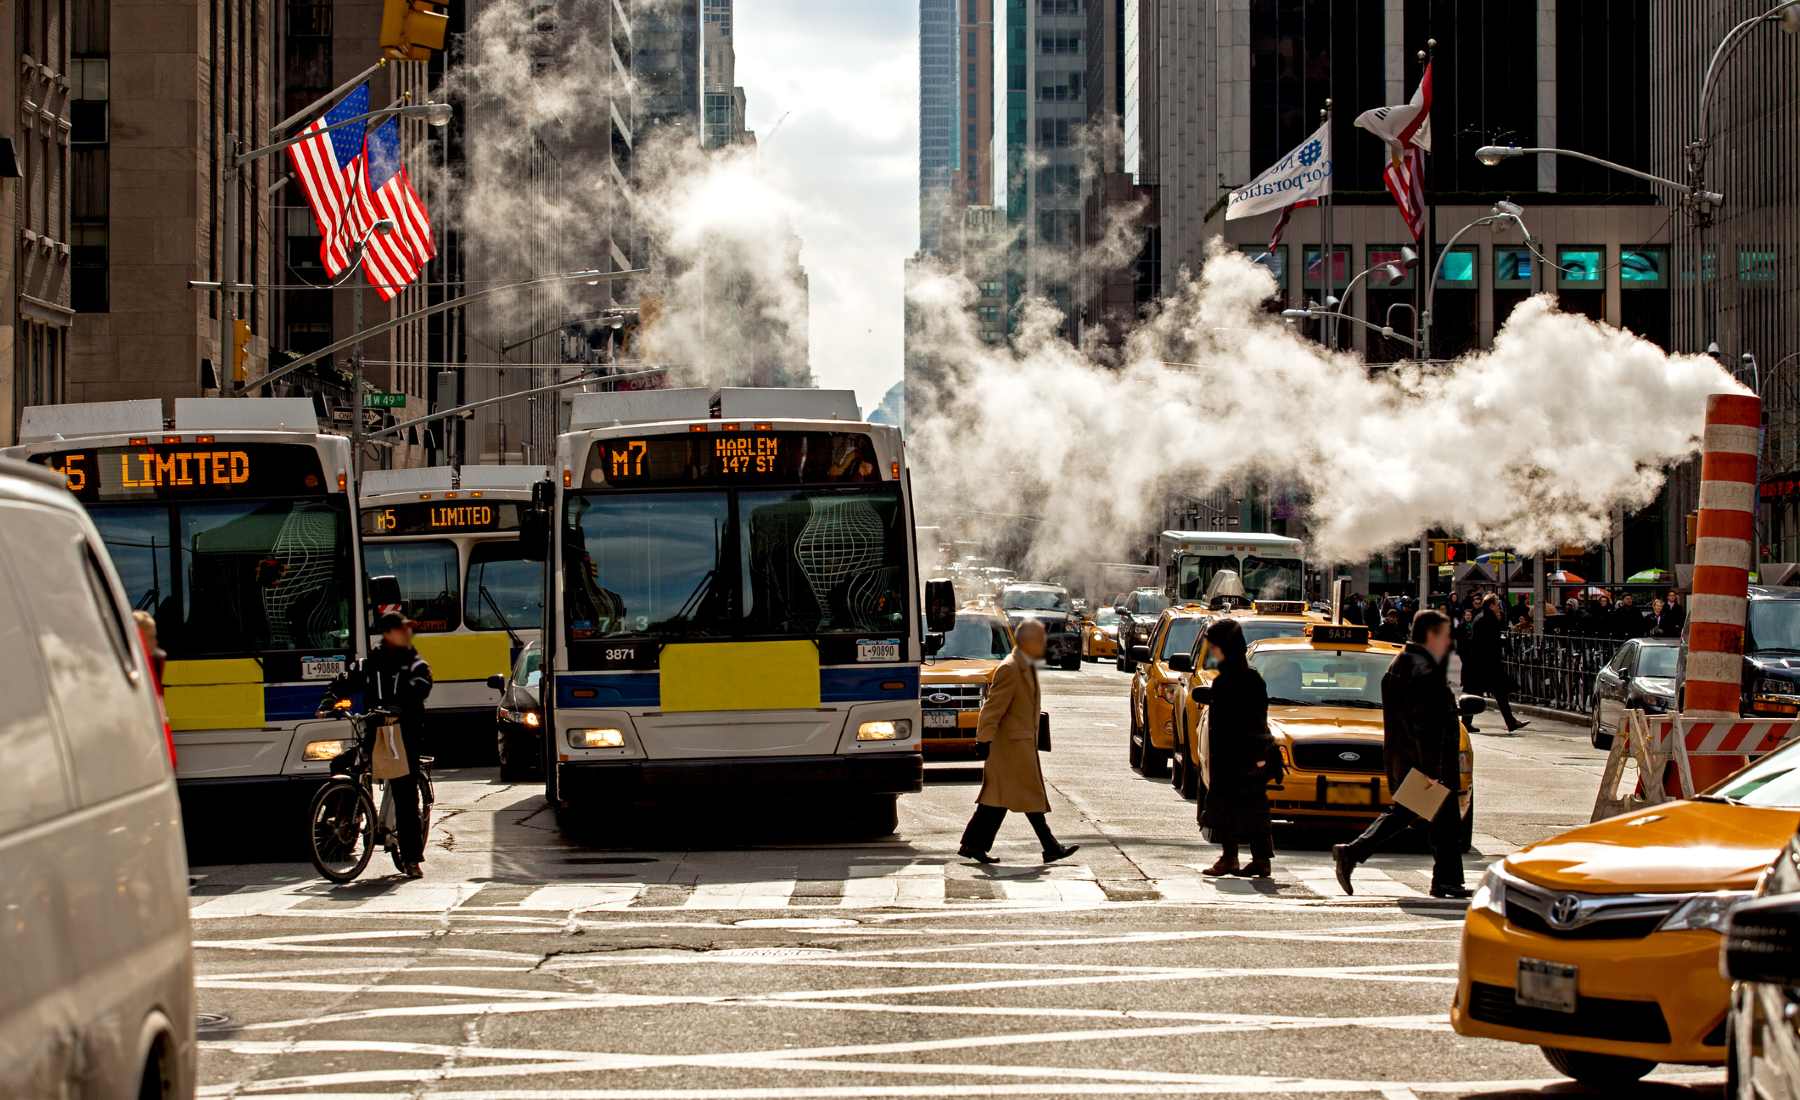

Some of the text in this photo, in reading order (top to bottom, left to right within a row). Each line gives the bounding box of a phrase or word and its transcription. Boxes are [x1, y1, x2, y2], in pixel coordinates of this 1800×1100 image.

[373, 394, 380, 405] W
[383, 394, 395, 405] 49
[716, 437, 778, 457] HARLEM
[612, 440, 647, 476] M7
[722, 456, 775, 473] 147 ST
[121, 451, 249, 488] LIMITED
[377, 506, 491, 529] M5 LIMITED
[605, 648, 635, 660] 3871
